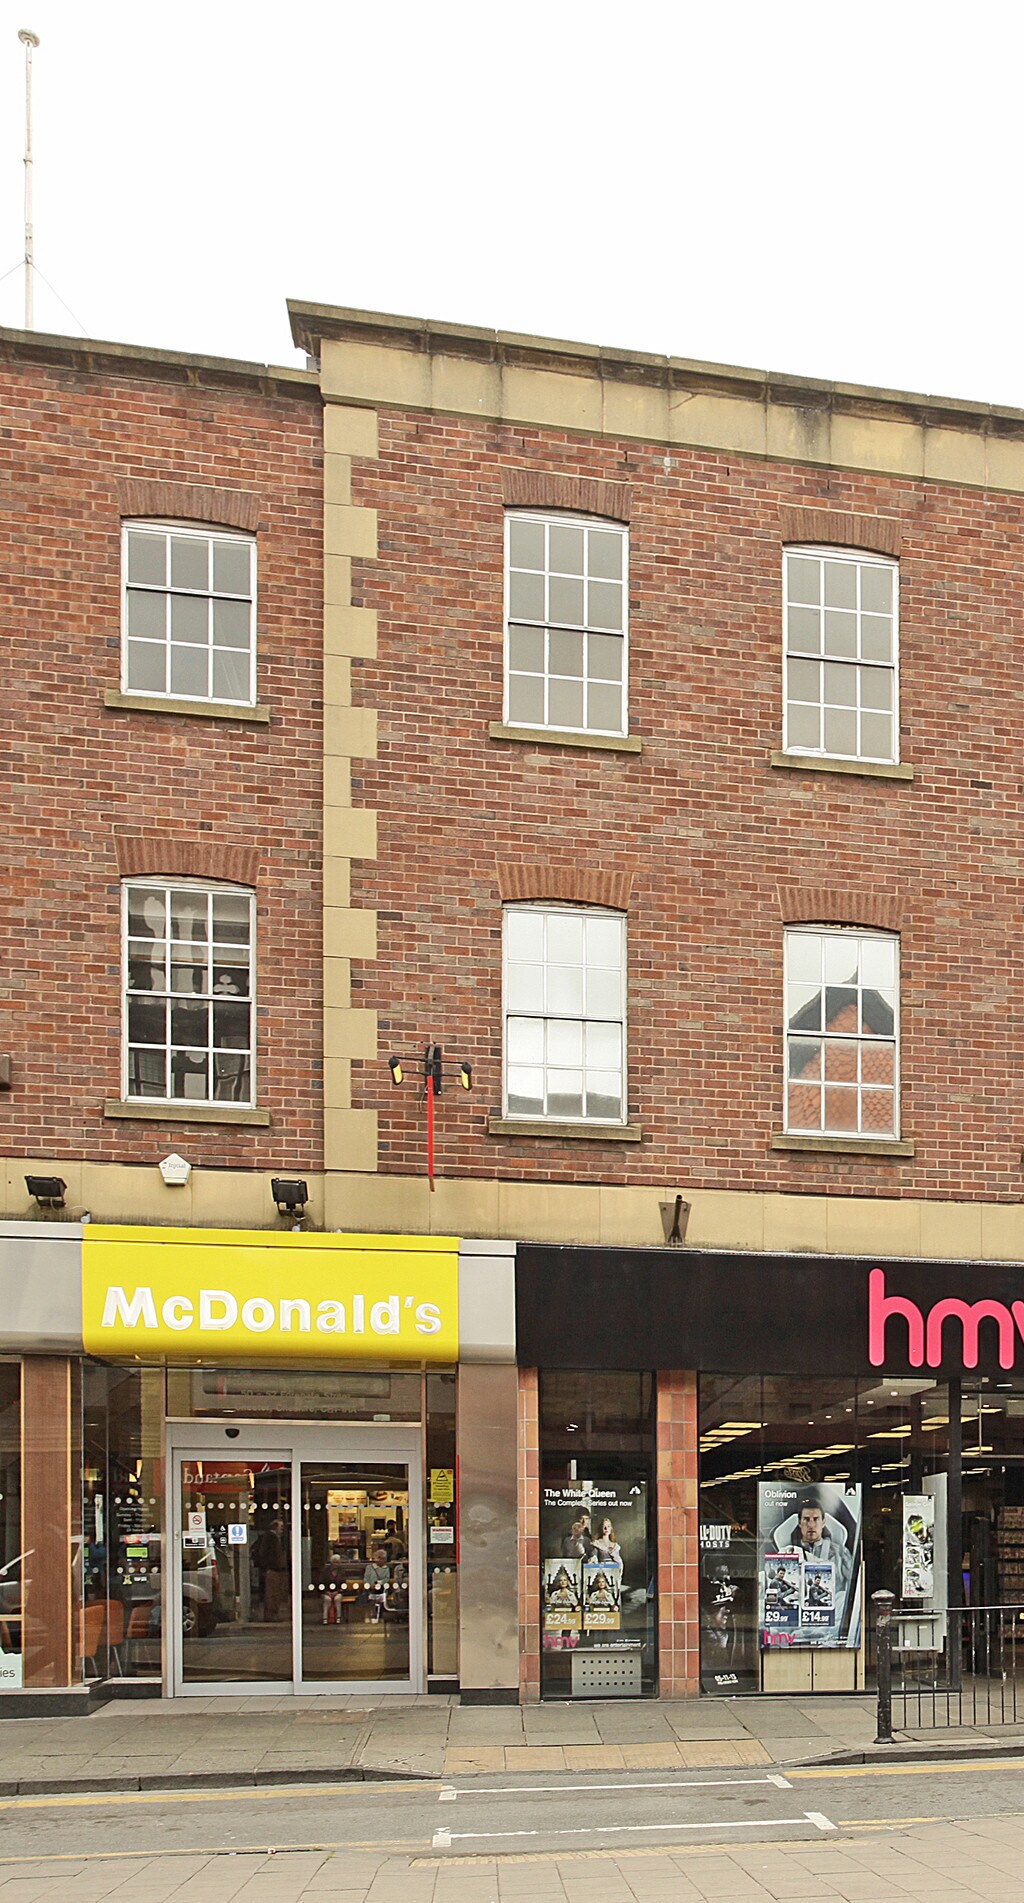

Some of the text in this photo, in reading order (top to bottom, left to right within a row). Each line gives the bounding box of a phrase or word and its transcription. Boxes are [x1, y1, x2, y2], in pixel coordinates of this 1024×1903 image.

[101, 1286, 442, 1335] McDonald's
[544, 1489, 616, 1498] The White Queen
[764, 1490, 797, 1499] Oblivion
[709, 1525, 732, 1540] DUTY
[544, 1632, 579, 1648] hmv
[763, 1629, 796, 1645] hmv
